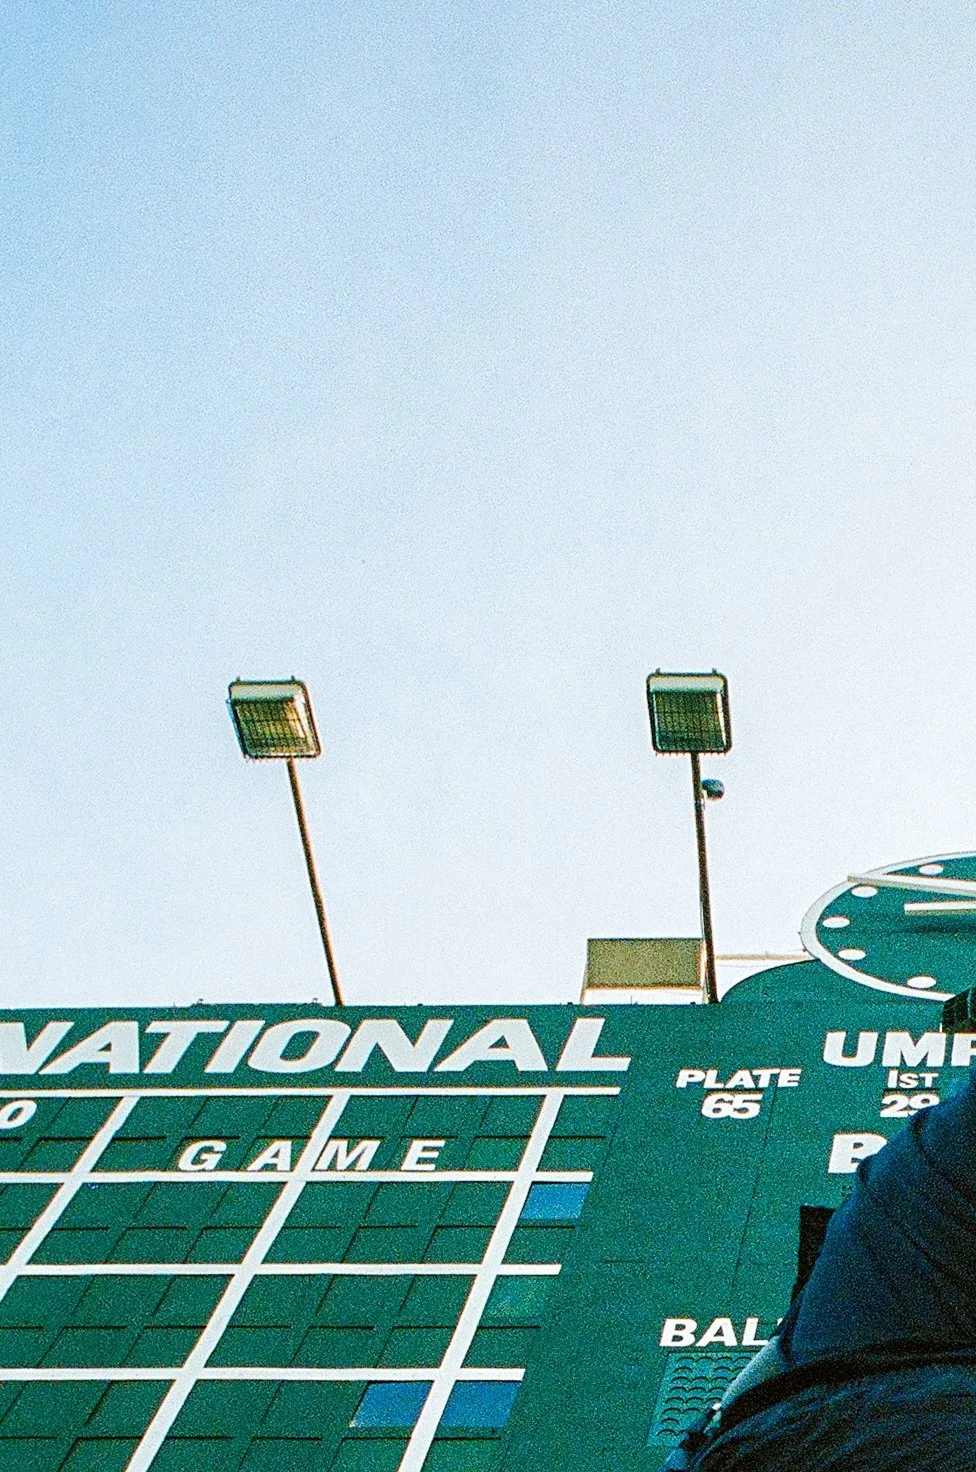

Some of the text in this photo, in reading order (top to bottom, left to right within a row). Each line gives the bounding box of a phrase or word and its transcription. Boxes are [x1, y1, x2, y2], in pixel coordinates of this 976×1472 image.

[675, 1068, 801, 1089] PLATE
[701, 1091, 763, 1120] 65
[659, 1317, 786, 1348] BAL
